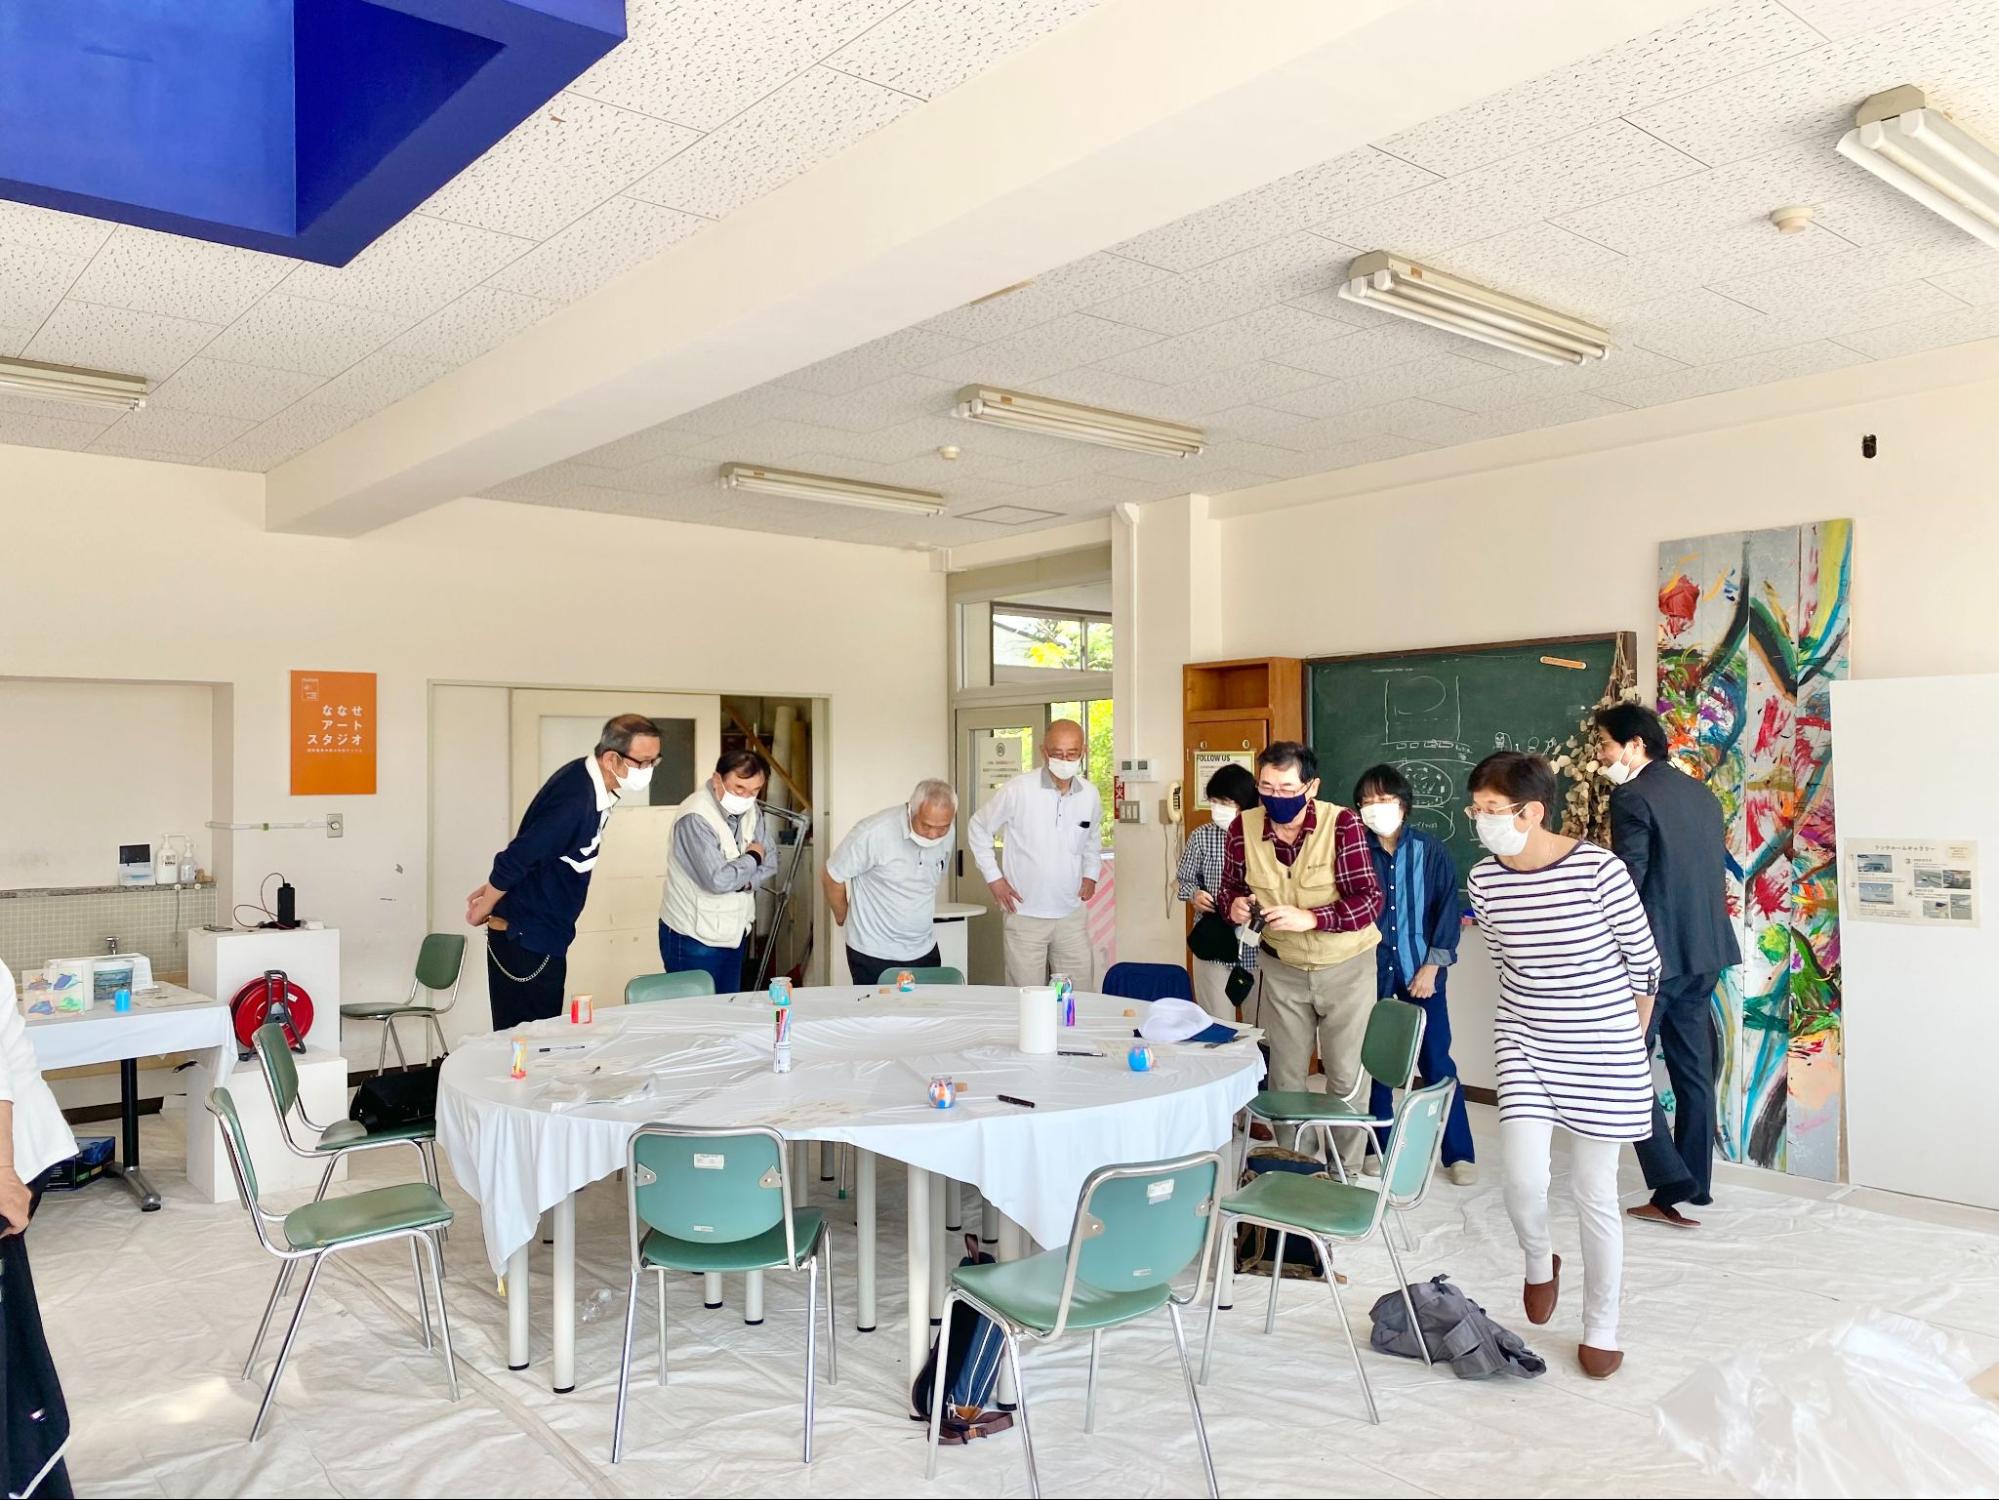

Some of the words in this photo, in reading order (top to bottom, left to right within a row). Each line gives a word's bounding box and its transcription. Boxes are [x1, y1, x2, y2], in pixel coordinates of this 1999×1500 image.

[322, 705, 363, 717] ななせ
[322, 719, 363, 731] アート
[308, 734, 363, 746] スタジオ
[1196, 754, 1221, 762] FOLLOW
[1222, 754, 1231, 762] US
